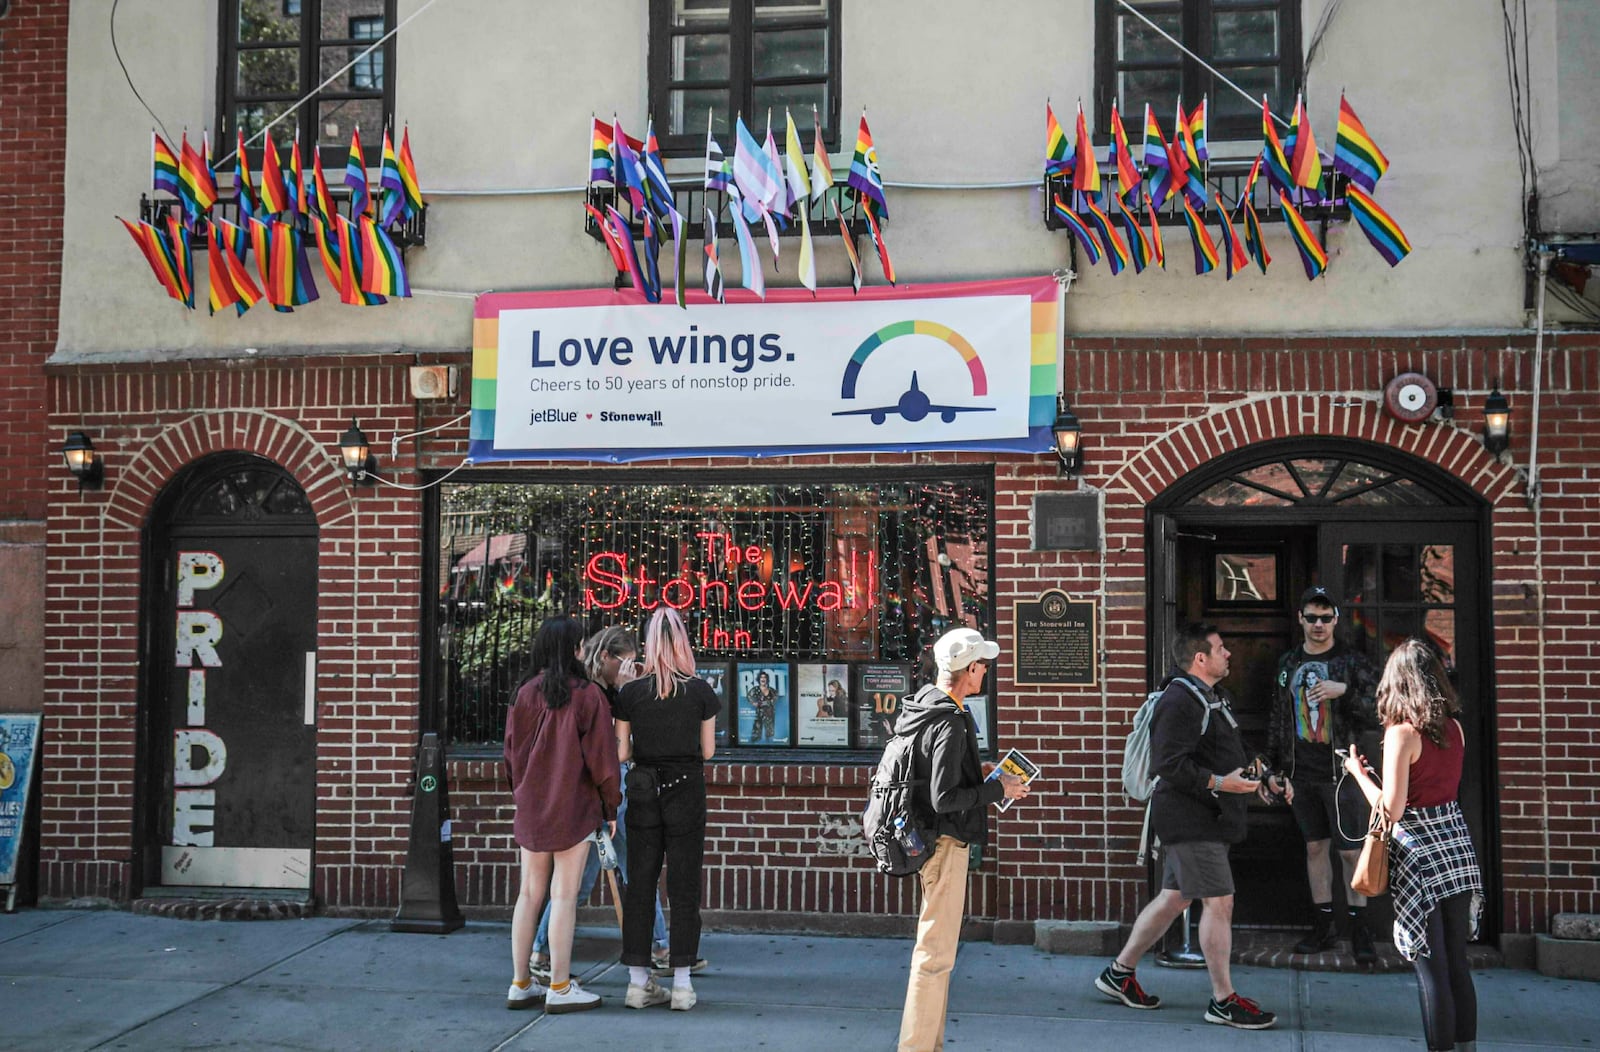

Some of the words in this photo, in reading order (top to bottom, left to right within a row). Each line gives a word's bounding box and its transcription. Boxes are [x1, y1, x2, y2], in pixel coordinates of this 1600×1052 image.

[531, 330, 633, 368] Love
[648, 325, 795, 373] wings.
[530, 378, 581, 392] Cheers
[587, 377, 600, 391] to
[605, 376, 623, 390] 50
[627, 378, 667, 394] years
[672, 375, 686, 390] of
[690, 375, 748, 391] nonstop
[753, 373, 796, 391] pride.
[529, 408, 577, 426] jetBlue
[600, 410, 662, 423] Stonewall
[697, 532, 763, 565] The
[584, 550, 875, 612] Stonewall
[702, 618, 752, 650] Inn
[1040, 620, 1072, 628] Stonewall
[172, 550, 227, 847] PRIDE
[873, 692, 897, 715] 10
